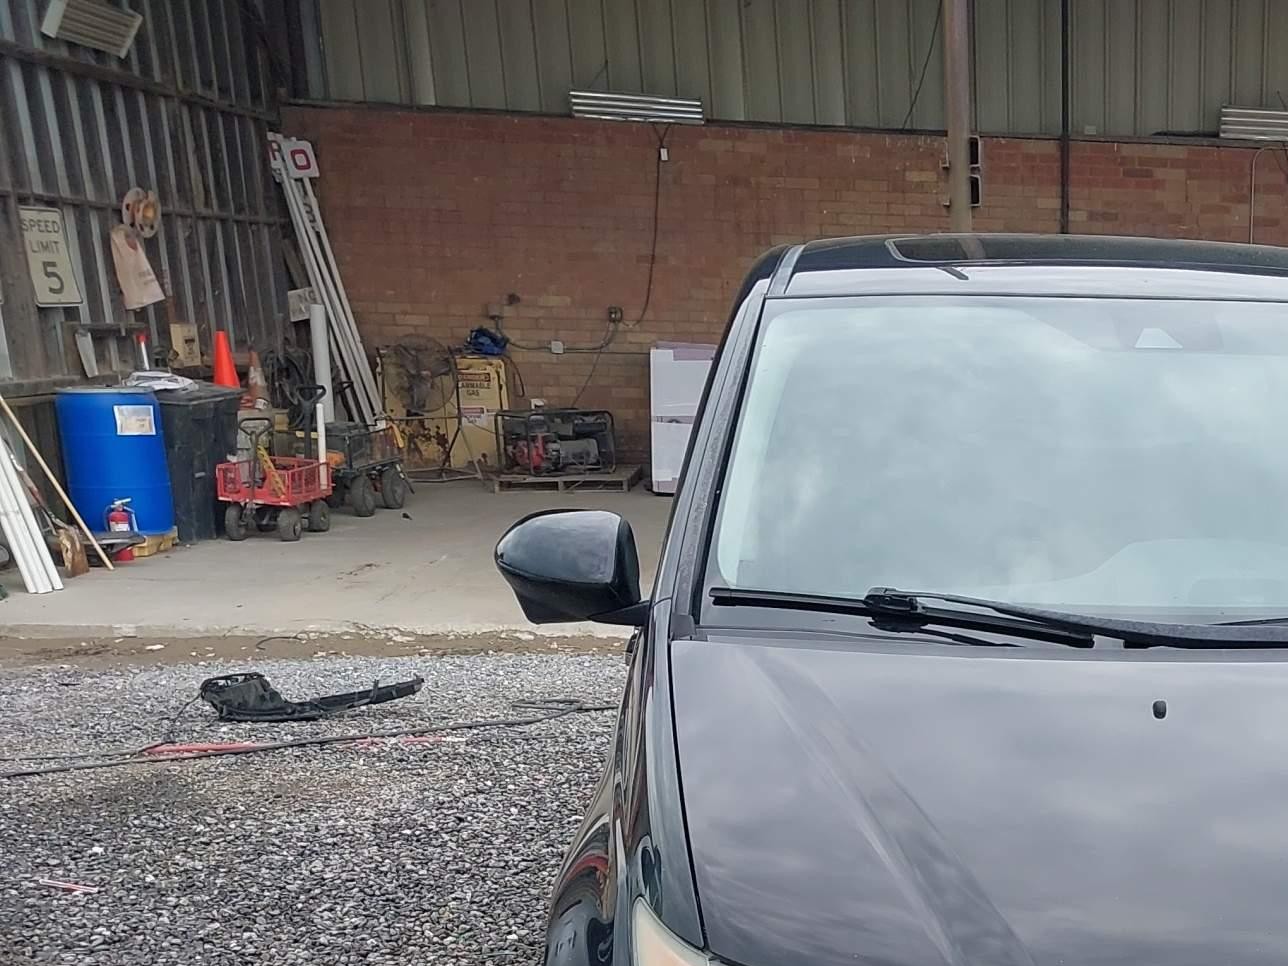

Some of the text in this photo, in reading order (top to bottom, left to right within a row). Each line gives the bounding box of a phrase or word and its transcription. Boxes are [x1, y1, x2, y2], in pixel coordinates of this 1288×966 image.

[21, 218, 60, 234] SPEED
[29, 240, 60, 253] LIMIT
[42, 261, 65, 295] 5
